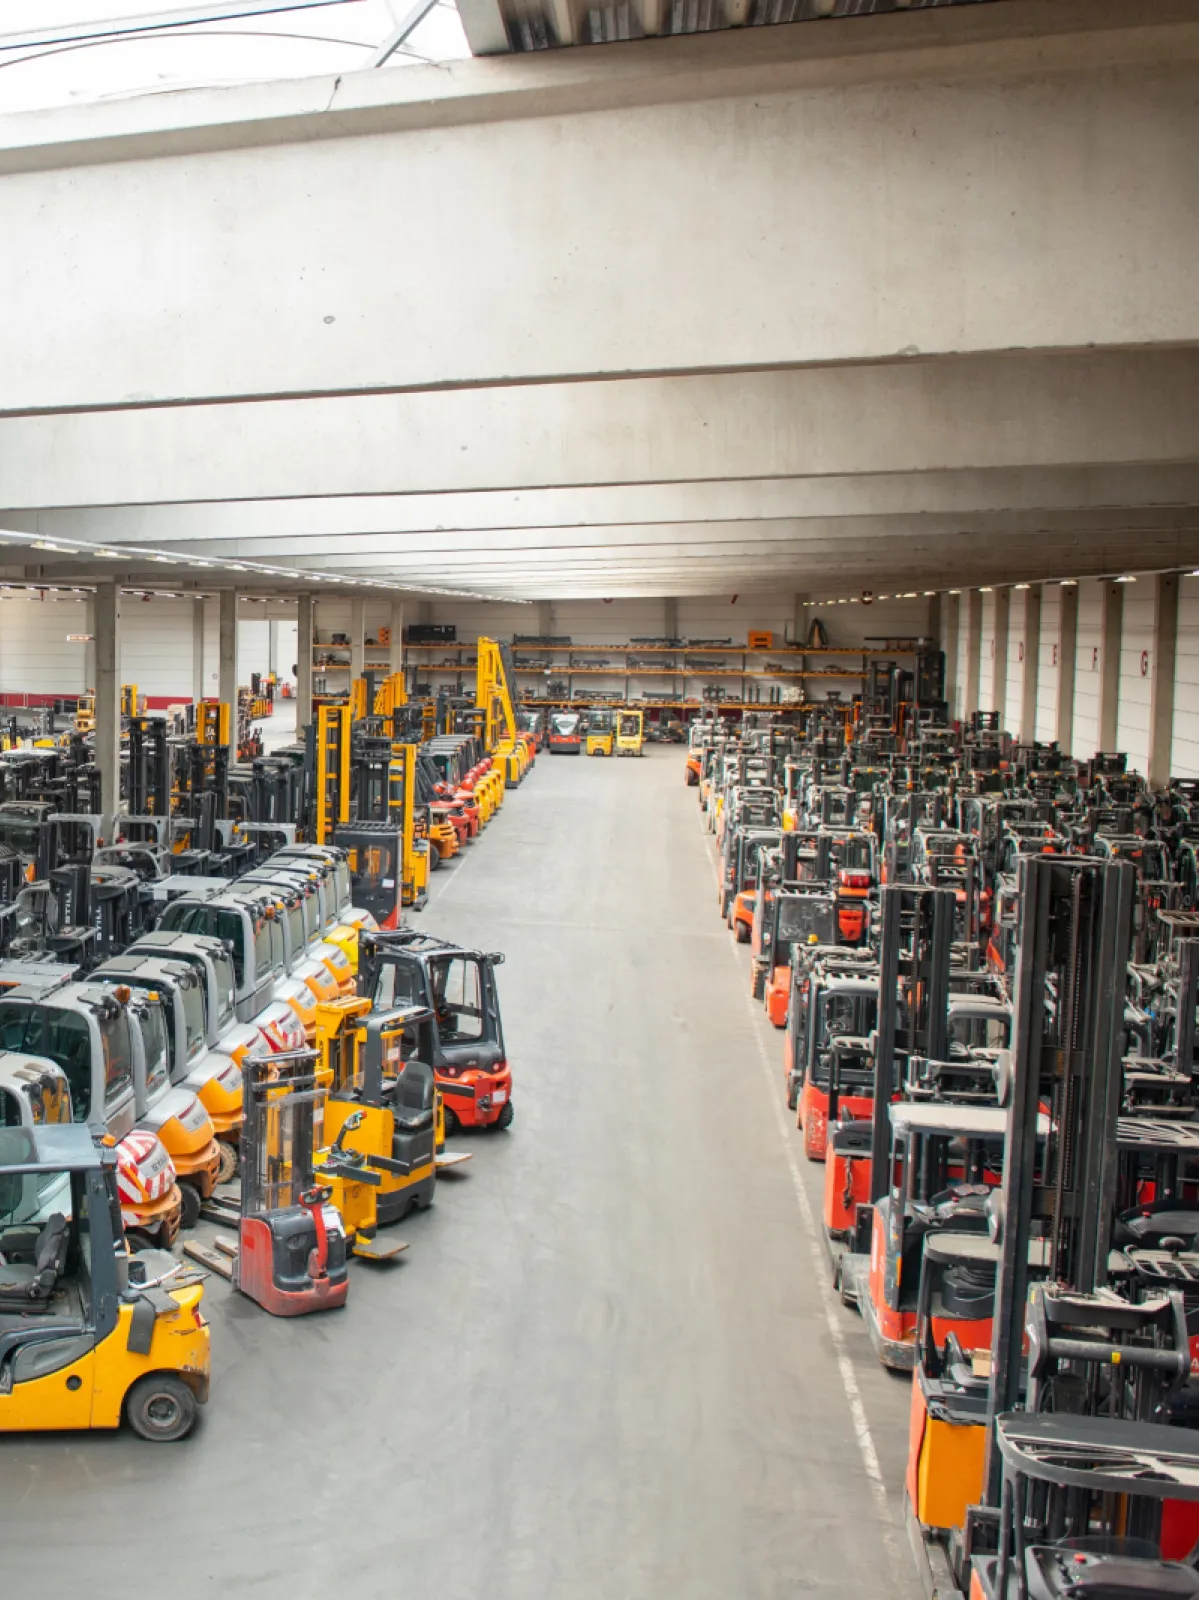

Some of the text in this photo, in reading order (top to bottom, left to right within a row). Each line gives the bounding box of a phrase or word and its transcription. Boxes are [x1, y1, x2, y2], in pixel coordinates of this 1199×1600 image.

[1092, 647, 1098, 671] F
[1140, 650, 1148, 676] G
[64, 889, 72, 925] STILL
[95, 905, 103, 941] STILL
